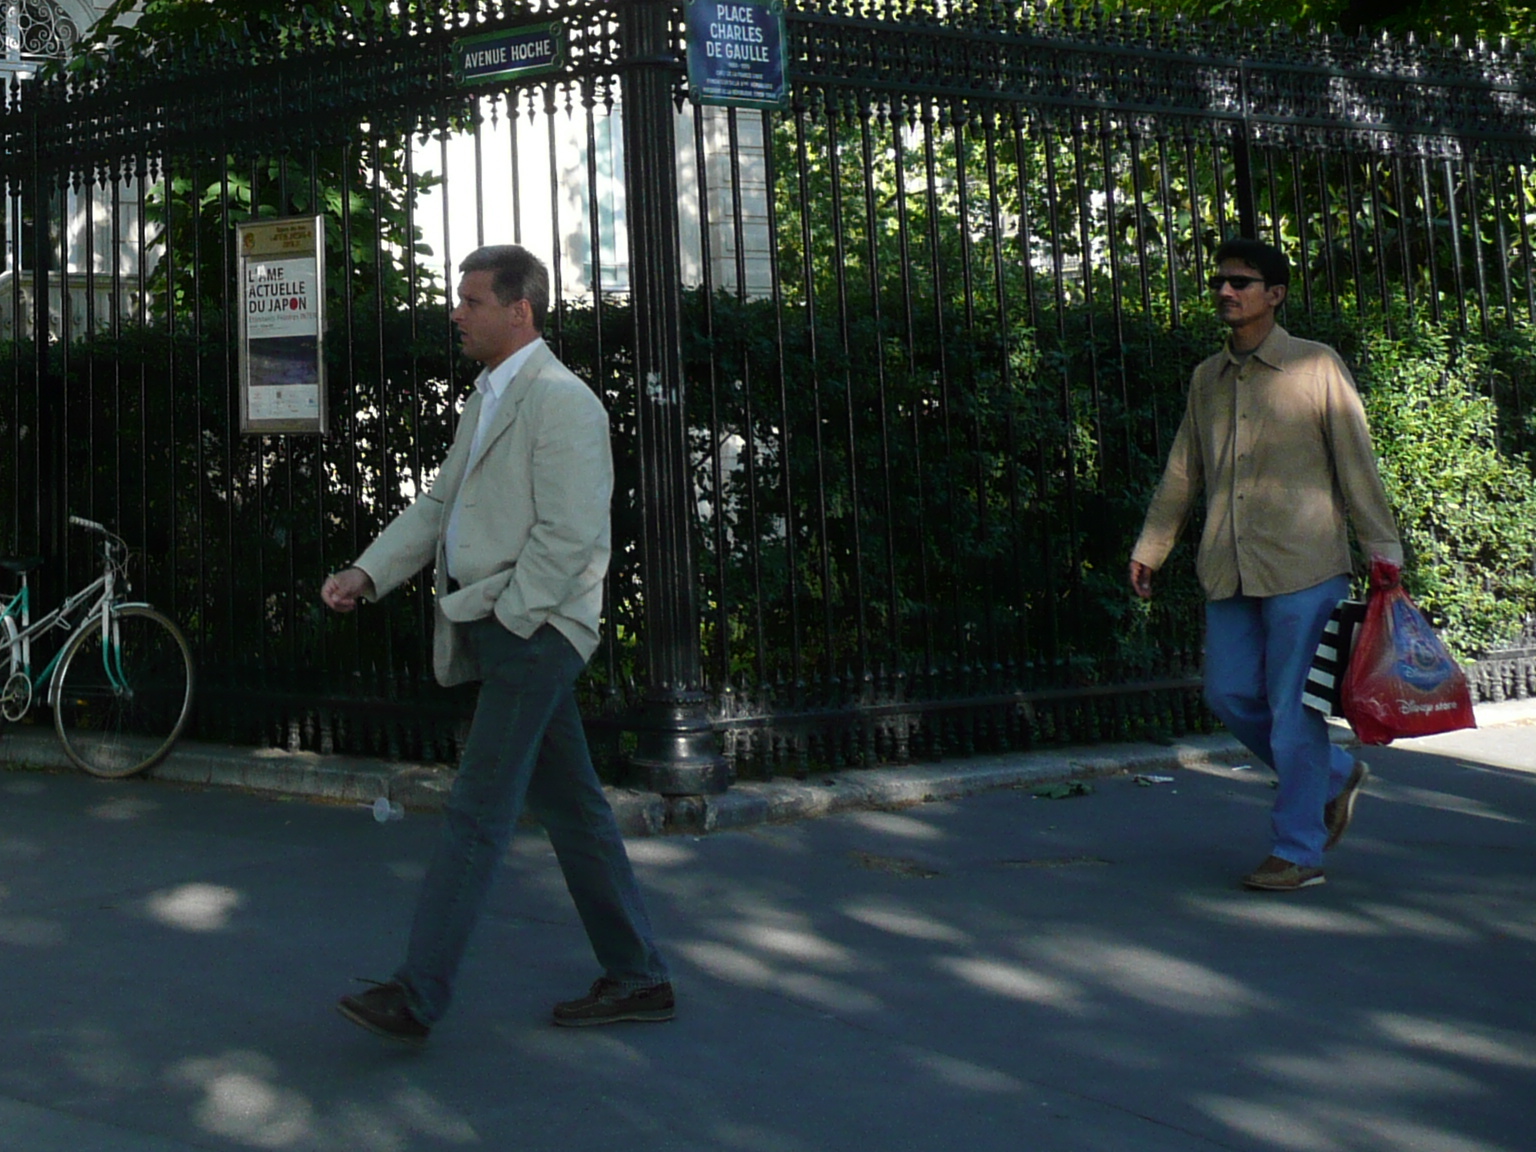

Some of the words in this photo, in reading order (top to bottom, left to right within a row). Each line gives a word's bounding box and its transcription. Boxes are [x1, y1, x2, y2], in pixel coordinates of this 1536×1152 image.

[717, 4, 754, 23] PLACE
[710, 23, 763, 43] CHARLES
[464, 47, 507, 69] AVENUE
[511, 39, 552, 61] HOCHE
[706, 41, 724, 58] DE
[725, 44, 770, 62] GAULLE
[248, 281, 306, 298] ACTUELLE
[249, 299, 266, 314] DU
[268, 297, 307, 313] JAPON
[1395, 699, 1433, 716] Disney
[1435, 701, 1457, 711] store
